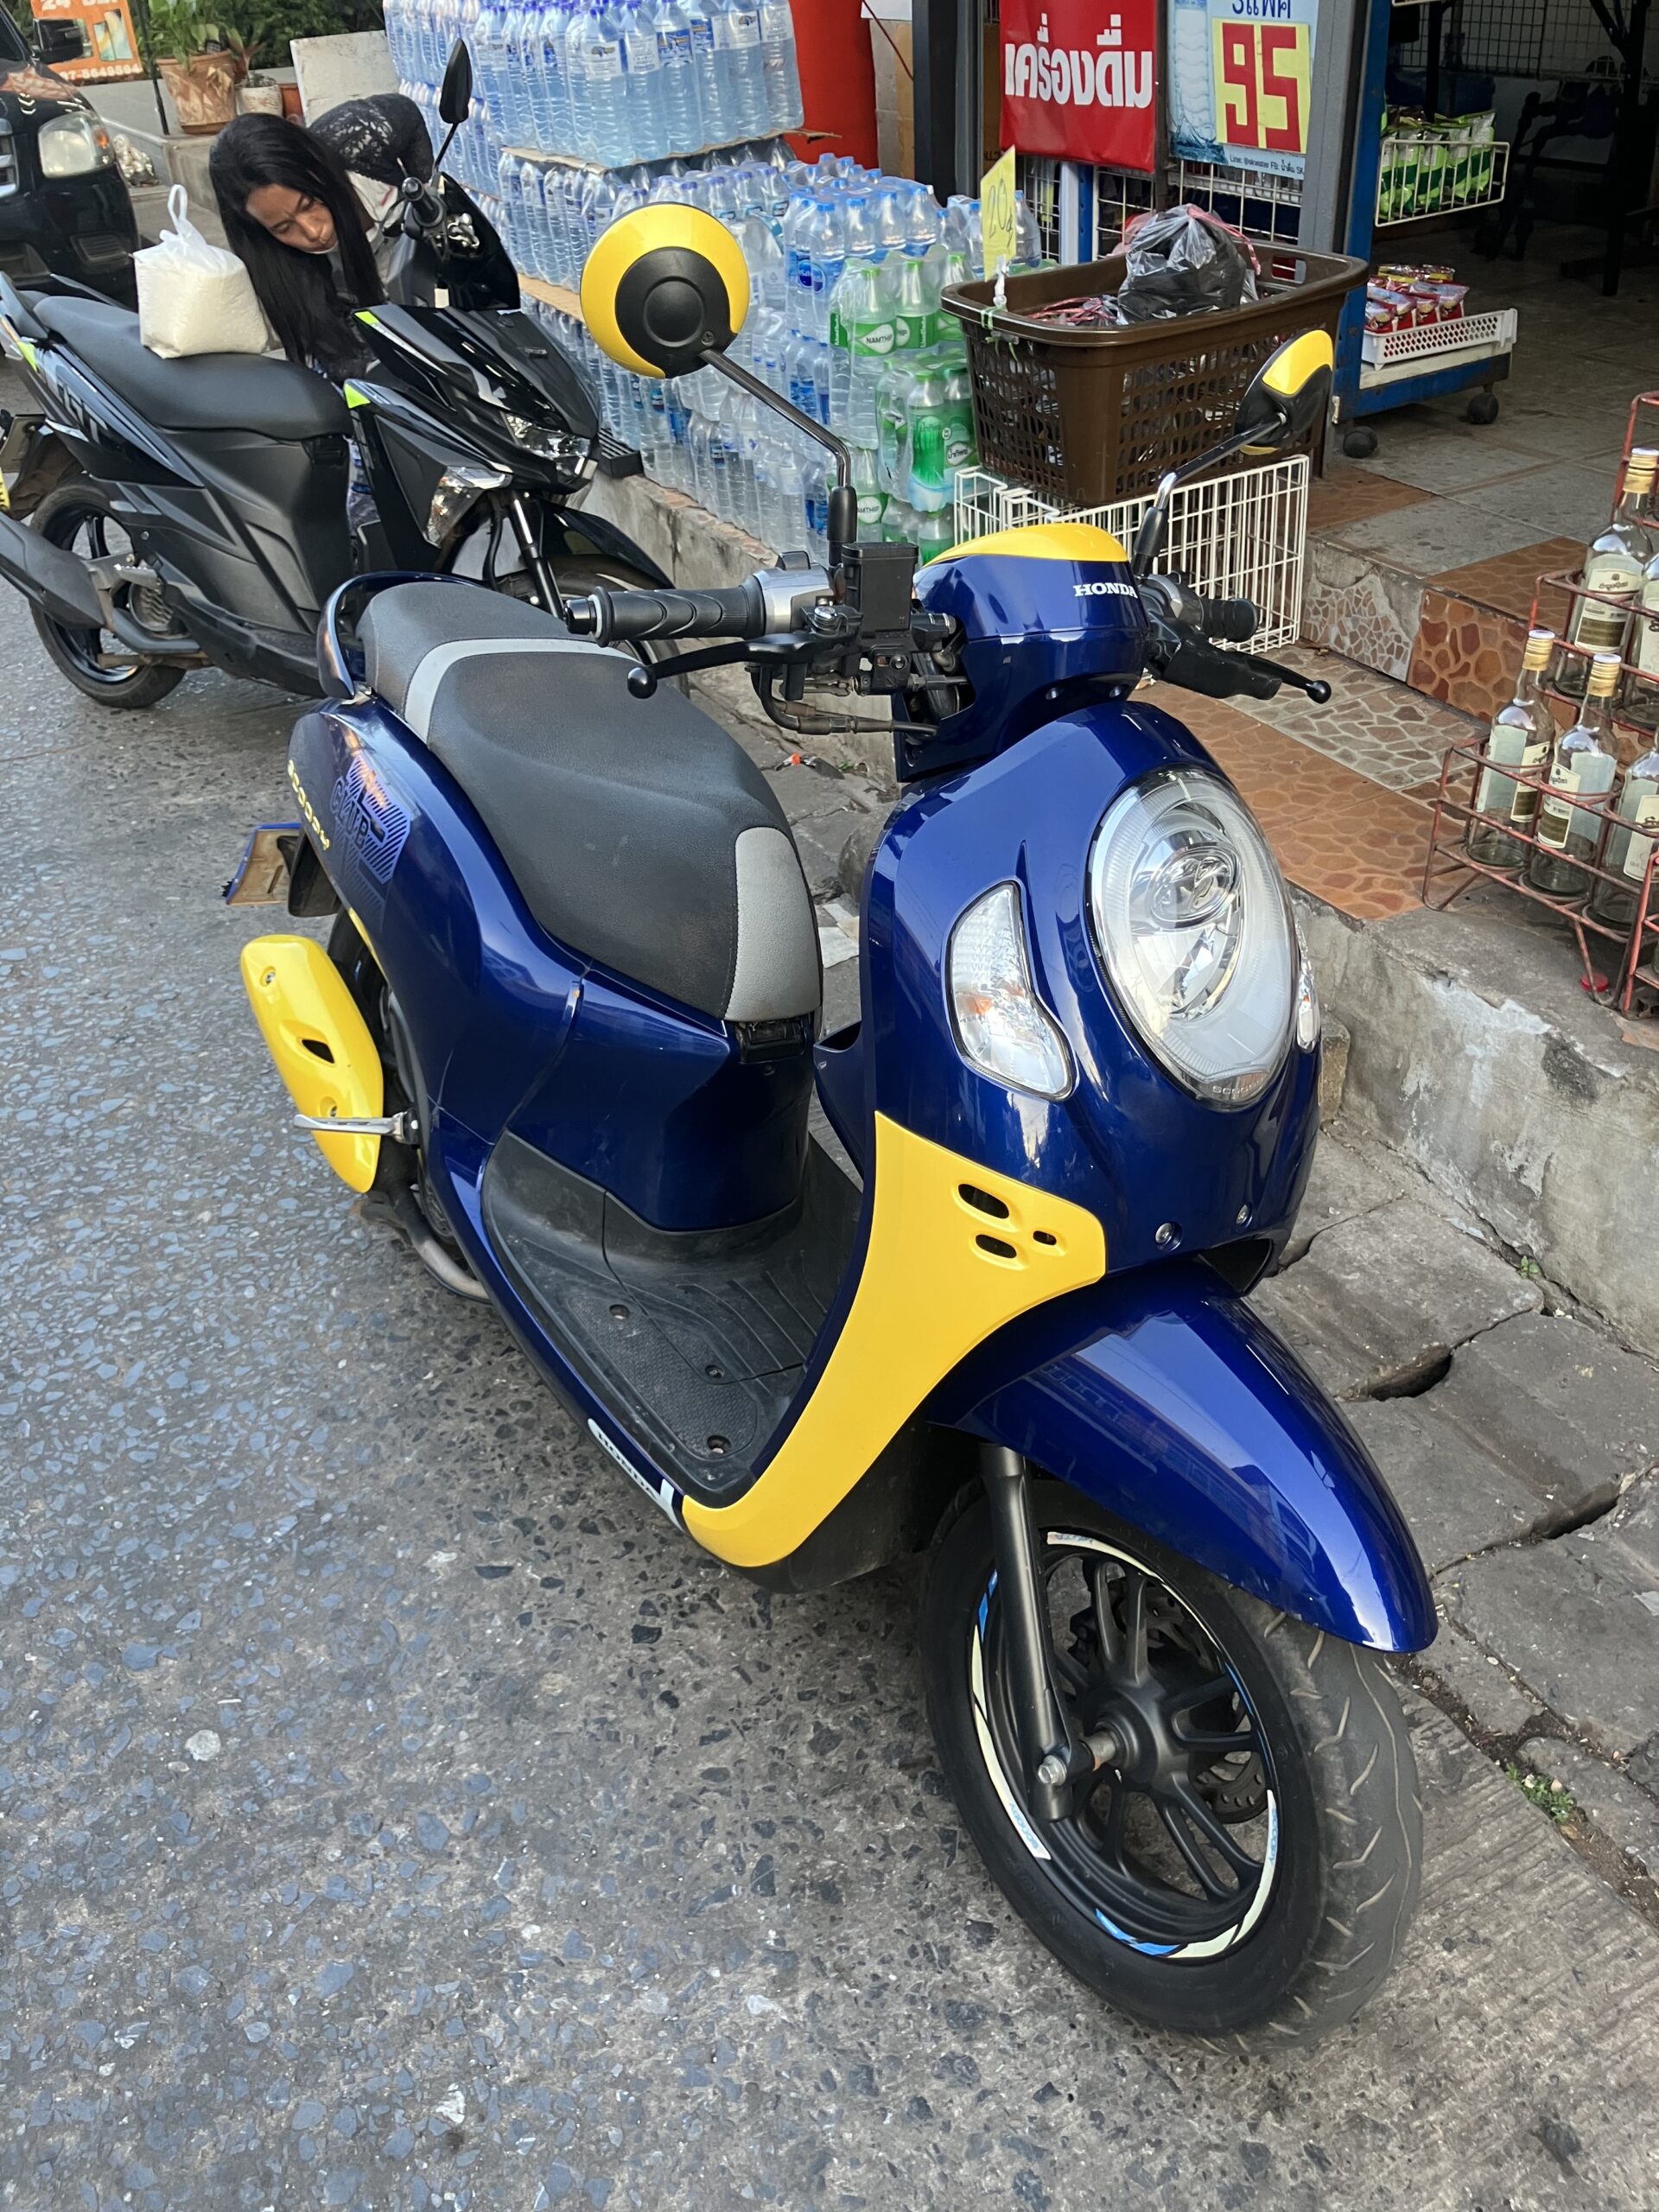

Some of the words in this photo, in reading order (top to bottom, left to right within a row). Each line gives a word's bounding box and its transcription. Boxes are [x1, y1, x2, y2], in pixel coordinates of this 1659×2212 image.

[1005, 13, 1153, 108] เครื่องดื่ม
[1222, 22, 1300, 152] 95
[1072, 582, 1138, 599] HONDA
[597, 1431, 659, 1501] HONDA
